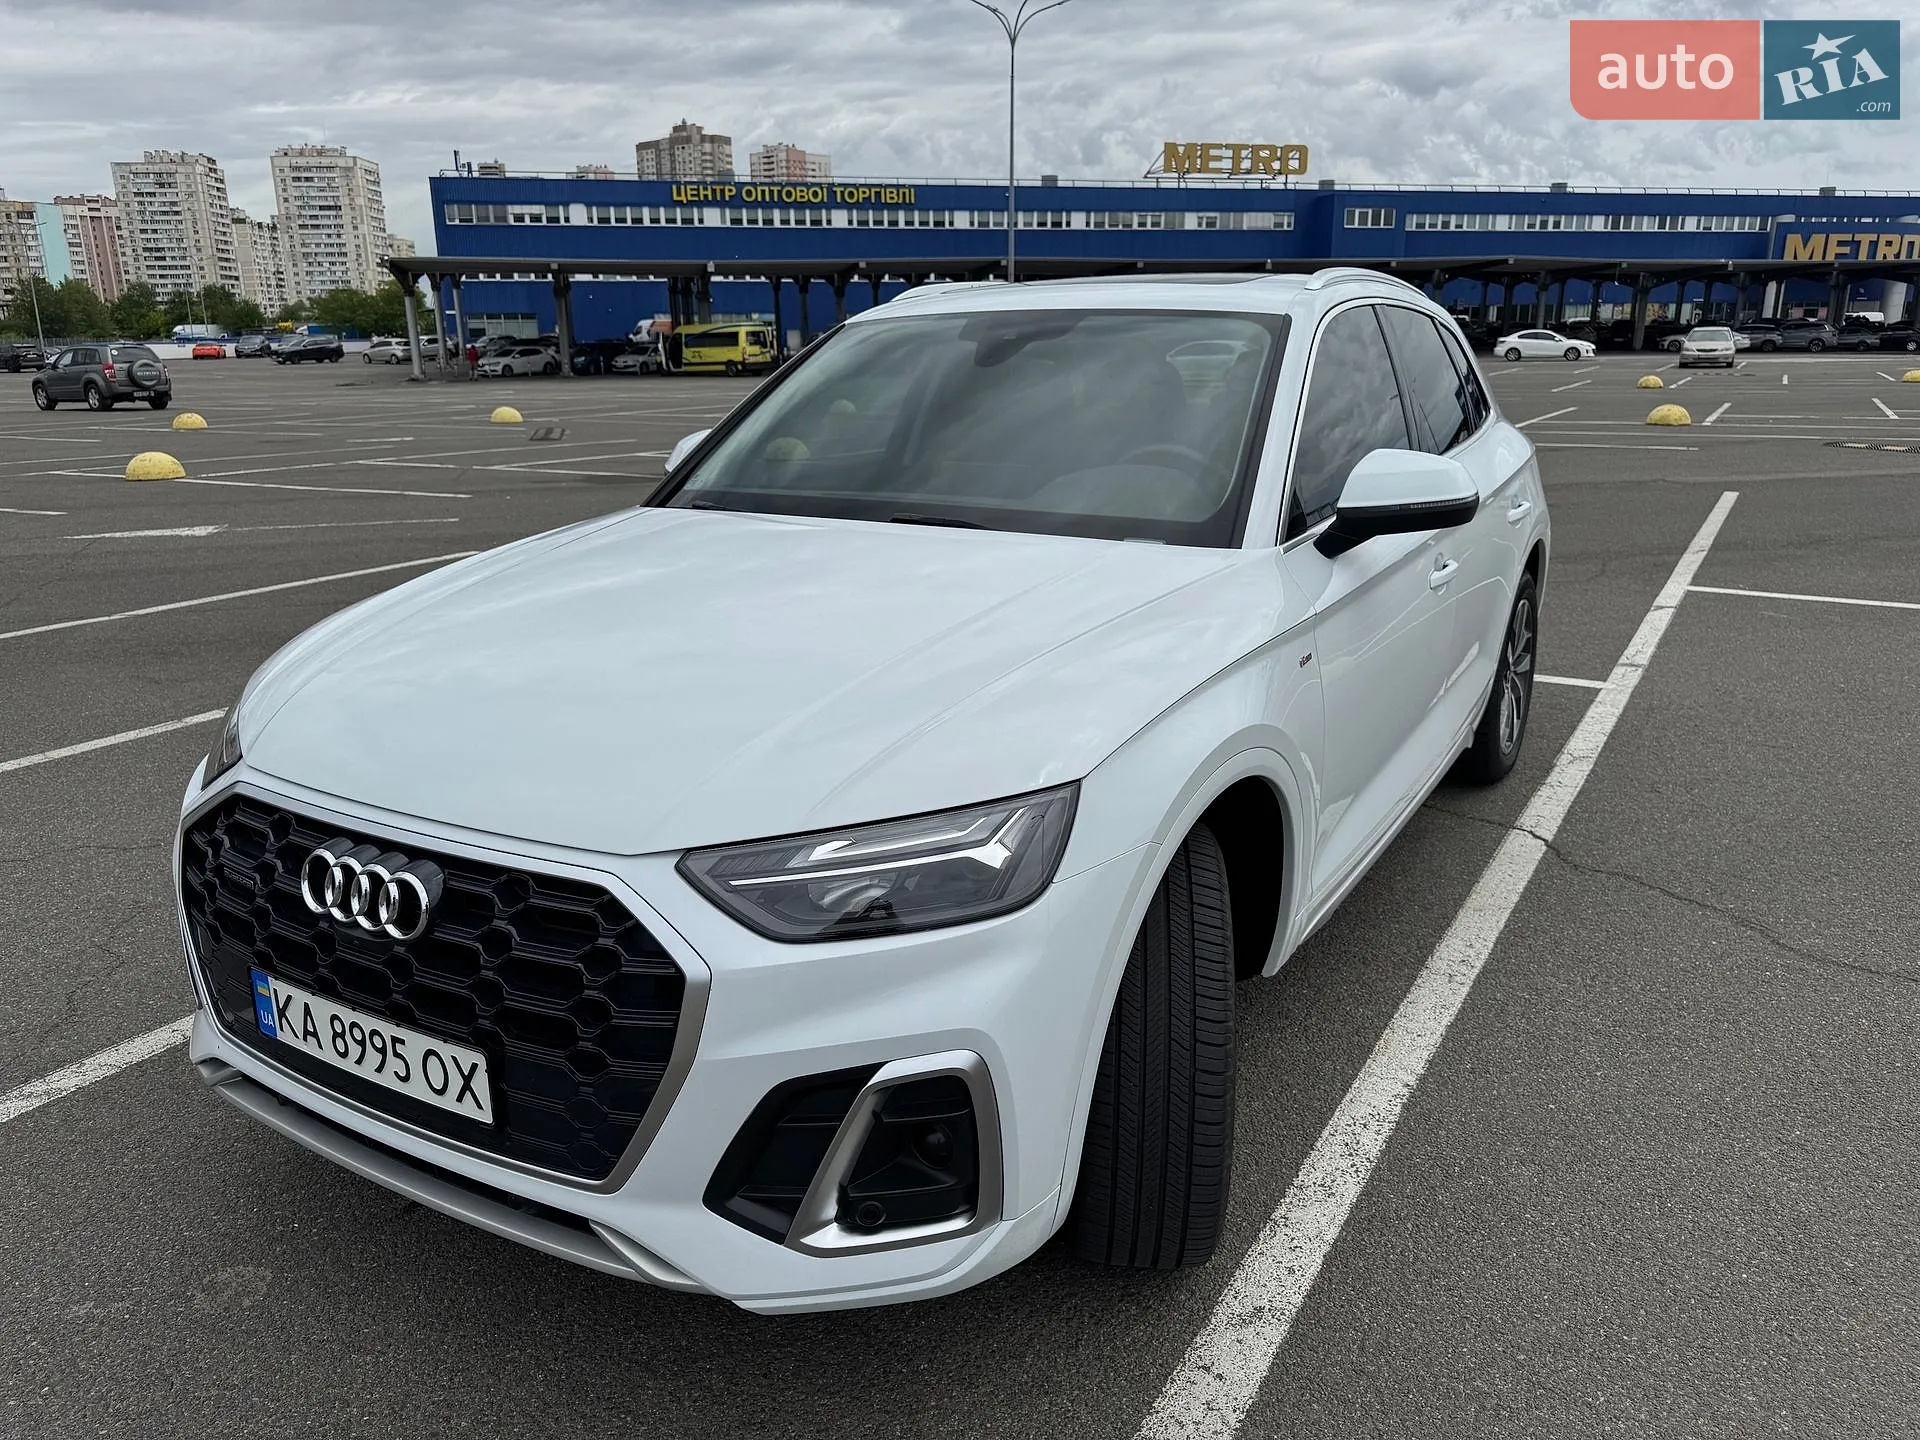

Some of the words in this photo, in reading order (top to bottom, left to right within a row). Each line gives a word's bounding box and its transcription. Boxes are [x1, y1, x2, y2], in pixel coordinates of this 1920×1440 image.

[1163, 142, 1309, 175] METRO
[671, 183, 736, 204] ЦЕНТР
[742, 184, 829, 203] ОПТОВОЇ
[833, 186, 915, 205] ТОРГІВЛІ
[260, 1011, 275, 1028] UA
[272, 987, 324, 1051] KA
[329, 1013, 412, 1083] 8995
[421, 1047, 485, 1111] OX
